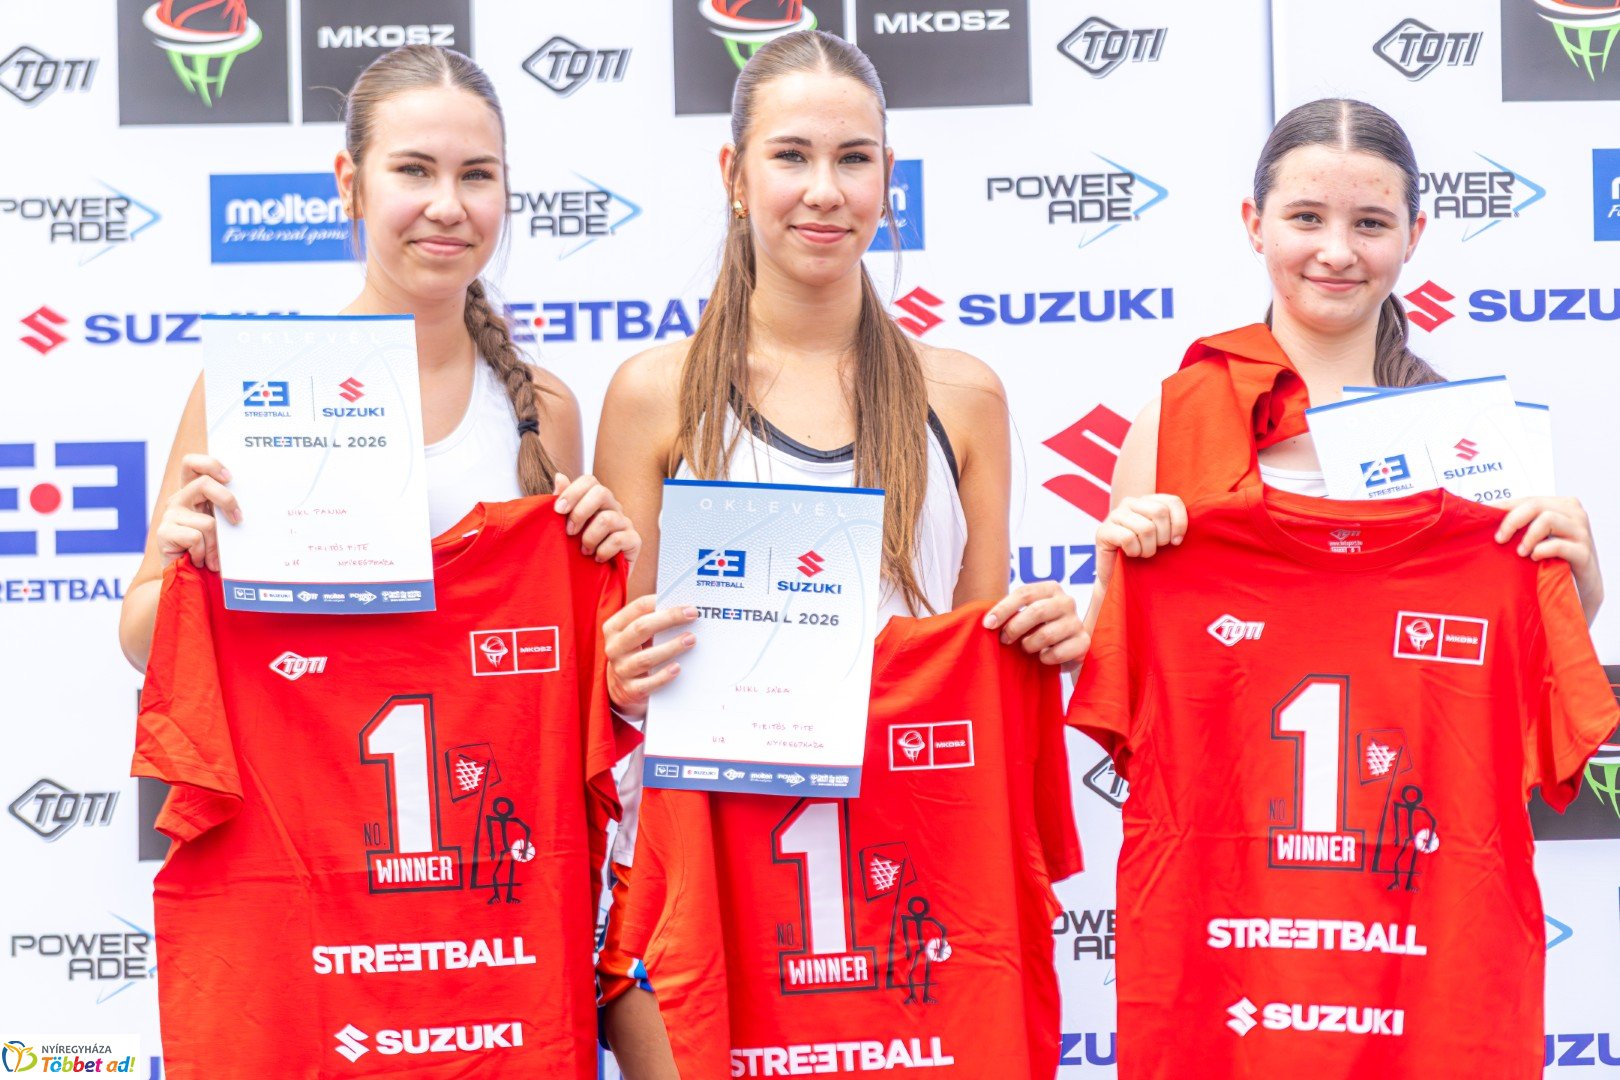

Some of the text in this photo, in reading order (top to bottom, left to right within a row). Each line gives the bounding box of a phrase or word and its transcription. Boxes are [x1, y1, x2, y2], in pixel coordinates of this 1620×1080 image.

[875, 9, 1011, 34] MKOSZ
[318, 25, 455, 48] MKOSZ
[987, 173, 1135, 201] POWER
[225, 193, 348, 225] molten
[508, 191, 612, 214] OWER
[1048, 198, 1133, 224] ADE
[1434, 195, 1513, 218] ADE
[50, 221, 129, 243] ADE
[530, 214, 610, 237] ADE
[958, 288, 1175, 326] SUZUKI
[1468, 288, 1620, 322] SUZU
[85, 314, 202, 345] SUZ
[322, 407, 385, 418] SUZUKI
[245, 436, 387, 448] STREETBALL 2026
[1444, 462, 1504, 480] SUZUKI
[1474, 489, 1512, 503] 2026
[697, 580, 745, 589] STREETBALL
[777, 580, 842, 595] SUZUKI
[799, 612, 839, 626] 2026
[519, 645, 552, 654] MKOSZ
[935, 740, 966, 749] MKOSZ
[1280, 682, 1341, 832] 1
[368, 703, 433, 854] 1
[1277, 834, 1356, 862] WINNER
[375, 856, 453, 884] WINNER
[780, 802, 847, 955] 1
[11, 932, 151, 957] POWER
[1207, 917, 1428, 956] STREETBALL
[312, 936, 537, 975] STREETBALL
[68, 956, 148, 981] ADE
[788, 956, 868, 985] WINNER
[1262, 1002, 1405, 1036] SUZUKI
[375, 1021, 523, 1055] SUZUKI
[730, 1036, 955, 1077] STREETBALL
